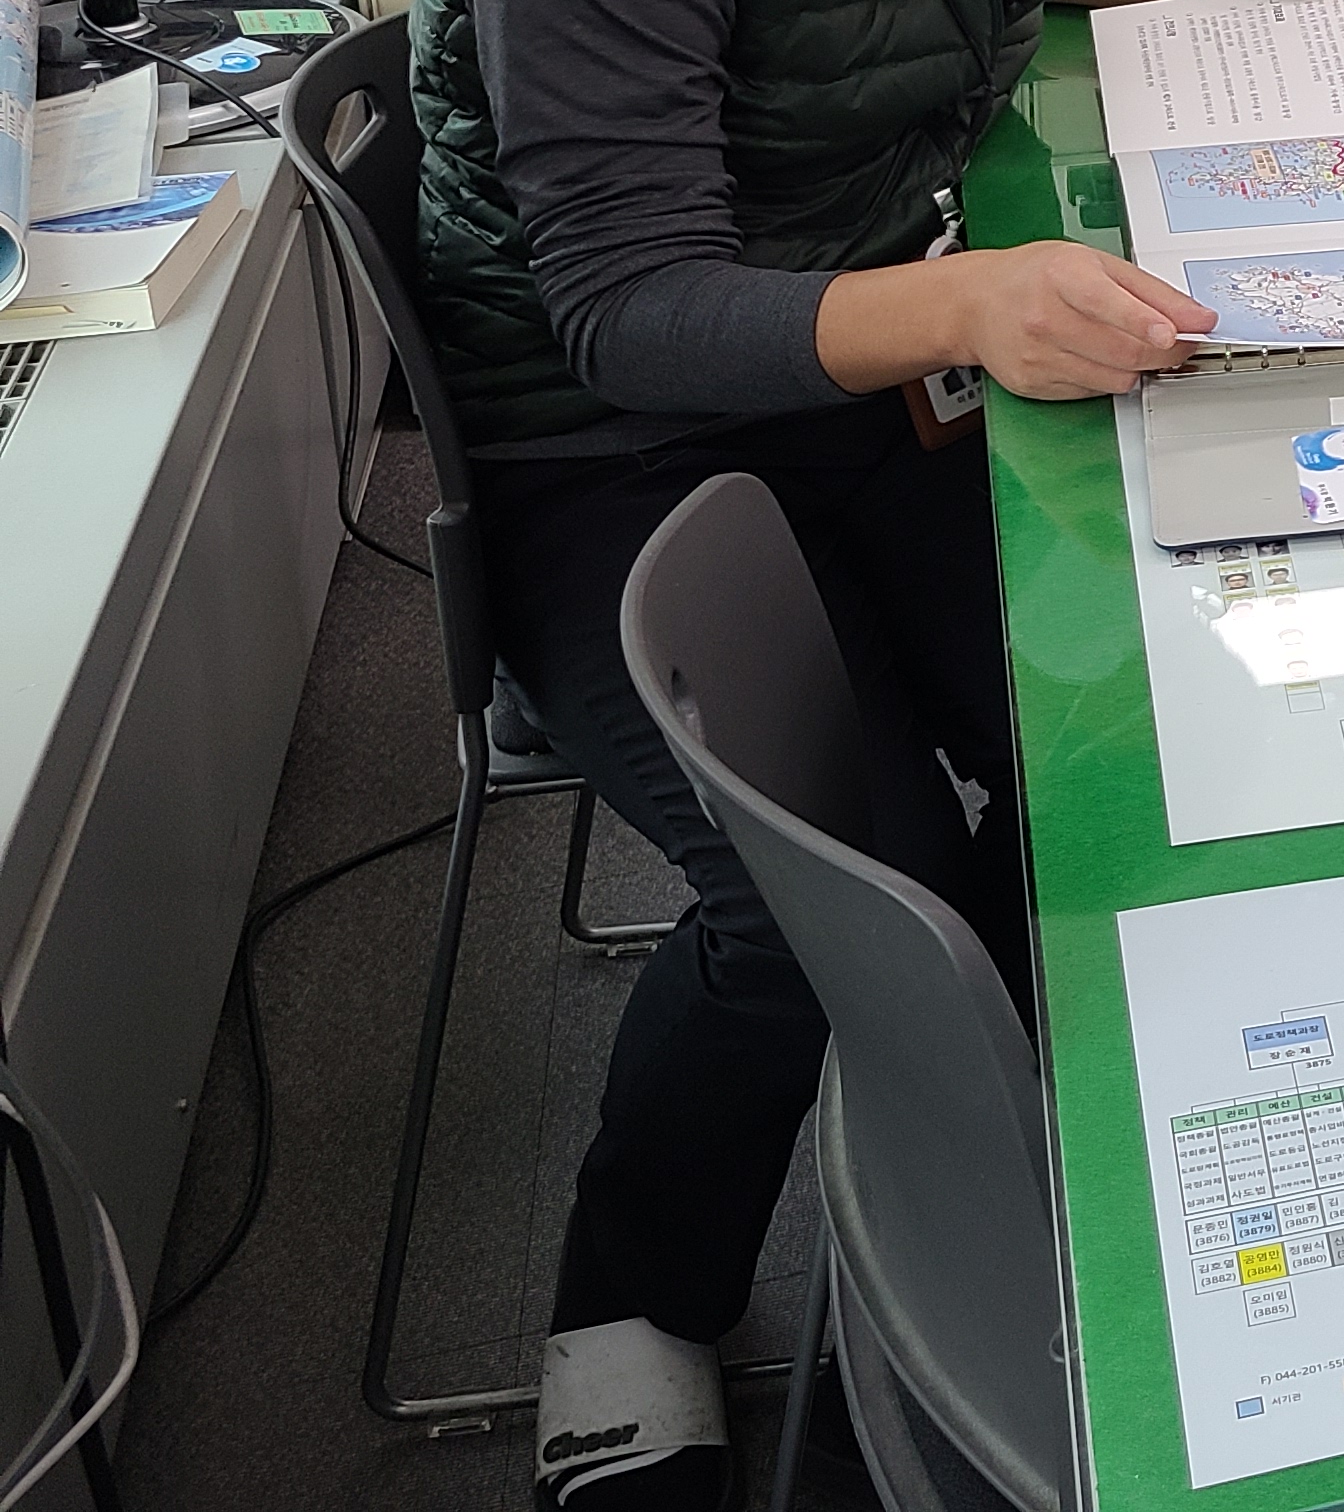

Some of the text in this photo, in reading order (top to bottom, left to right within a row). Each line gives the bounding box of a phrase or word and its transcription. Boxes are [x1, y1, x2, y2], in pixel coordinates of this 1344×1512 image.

[1252, 1023, 1321, 1043] 도로정책과장
[1304, 1058, 1333, 1070] 3875
[1267, 1099, 1292, 1111] 예산
[1225, 1106, 1250, 1119] 관리
[1181, 1115, 1207, 1128] 정책
[1238, 1223, 1277, 1239] (3879)
[1194, 1232, 1231, 1248] (3876)
[1252, 1303, 1290, 1320] (3885)
